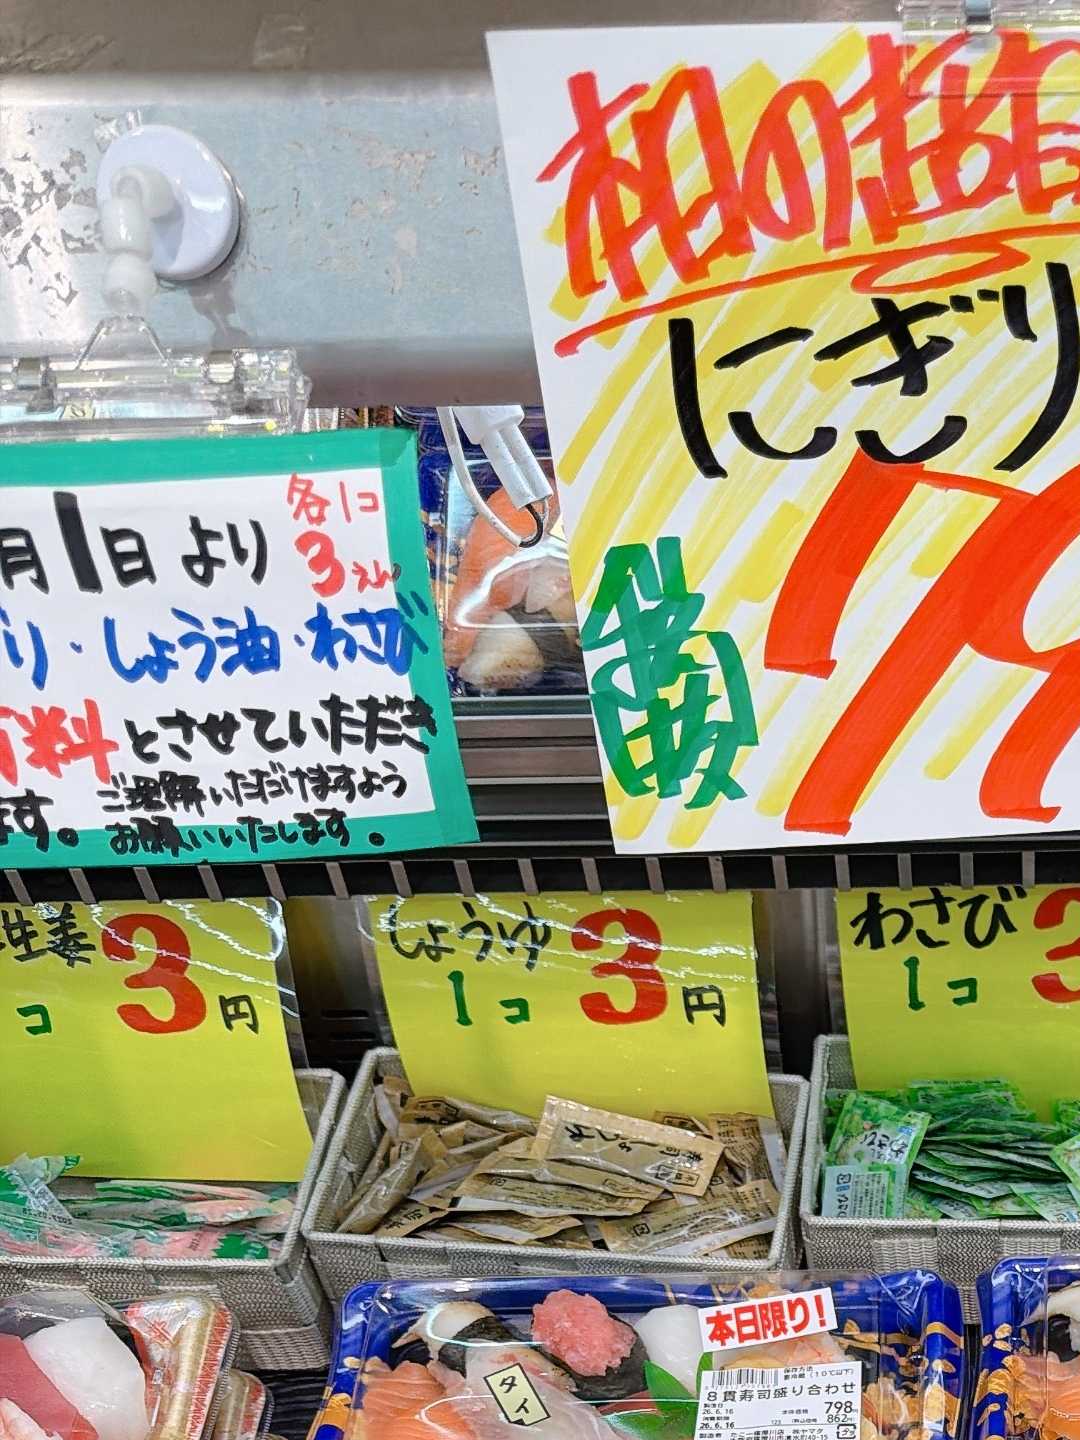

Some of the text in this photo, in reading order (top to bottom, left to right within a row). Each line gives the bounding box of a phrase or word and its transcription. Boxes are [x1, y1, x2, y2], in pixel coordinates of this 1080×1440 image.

[389, 901, 553, 970] しょうゆ
[850, 886, 1028, 950] わさび
[706, 1295, 827, 1346] 本日限り!
[497, 1374, 530, 1415] タイ
[707, 1382, 856, 1402] 8貫寿司盛り合わせ
